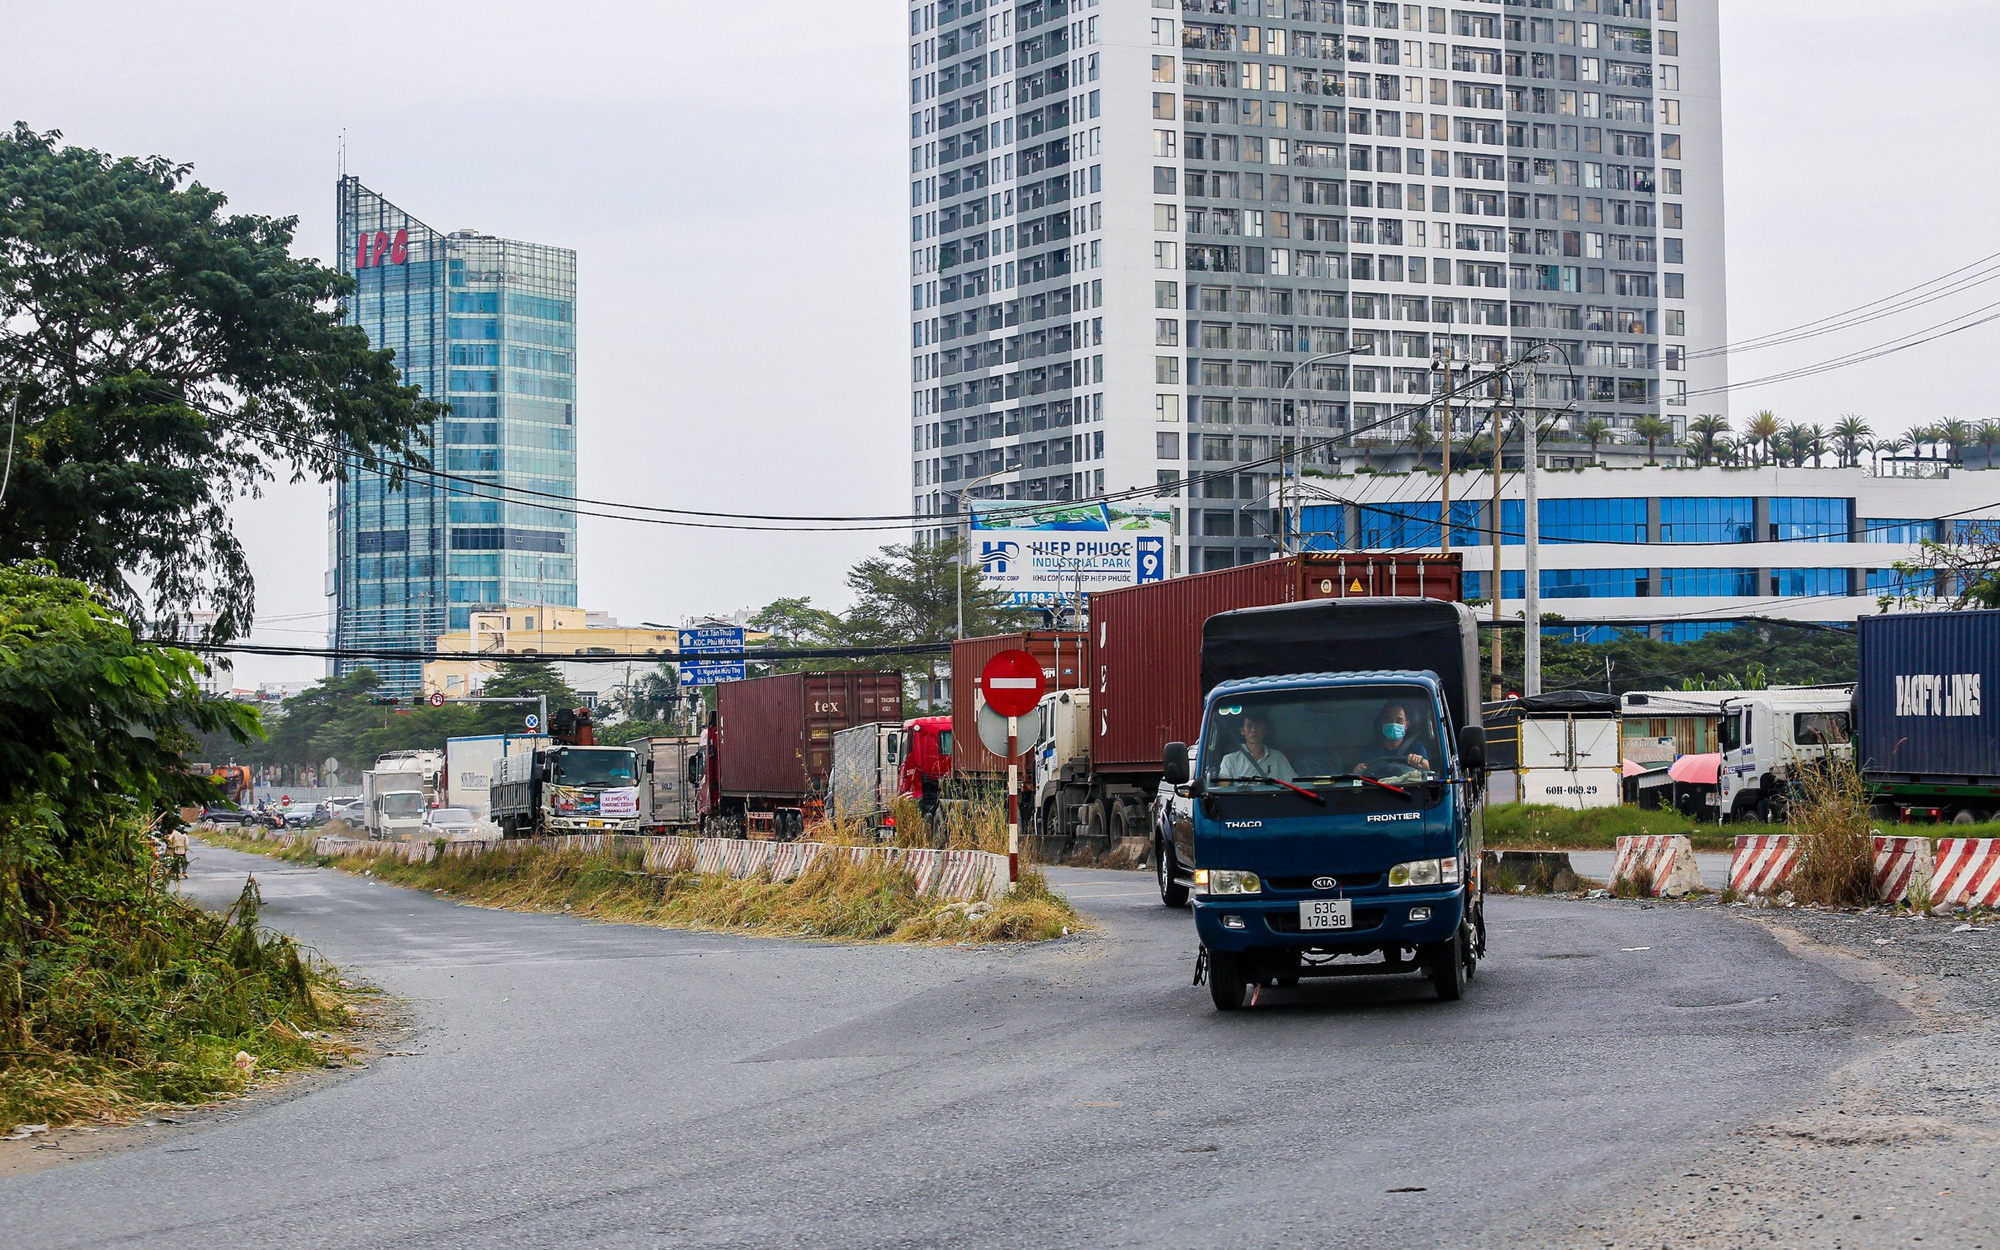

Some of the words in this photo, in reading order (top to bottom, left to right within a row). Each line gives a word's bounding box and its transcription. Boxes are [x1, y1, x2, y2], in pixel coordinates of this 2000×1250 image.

[356, 229, 407, 268] IPC
[1033, 558, 1098, 567] INDUSTRIAL
[1102, 558, 1130, 568] PARK
[1143, 554, 1158, 575] 9
[1895, 674, 1942, 716] PACIFIC
[1945, 673, 1981, 717] LINES
[814, 700, 839, 713] tex
[1545, 785, 1598, 795] 60H-069.29
[1367, 812, 1421, 823] FRONTIER
[1316, 879, 1333, 887] KIA
[1314, 902, 1337, 914] 63C
[1307, 914, 1346, 927] 178.98
